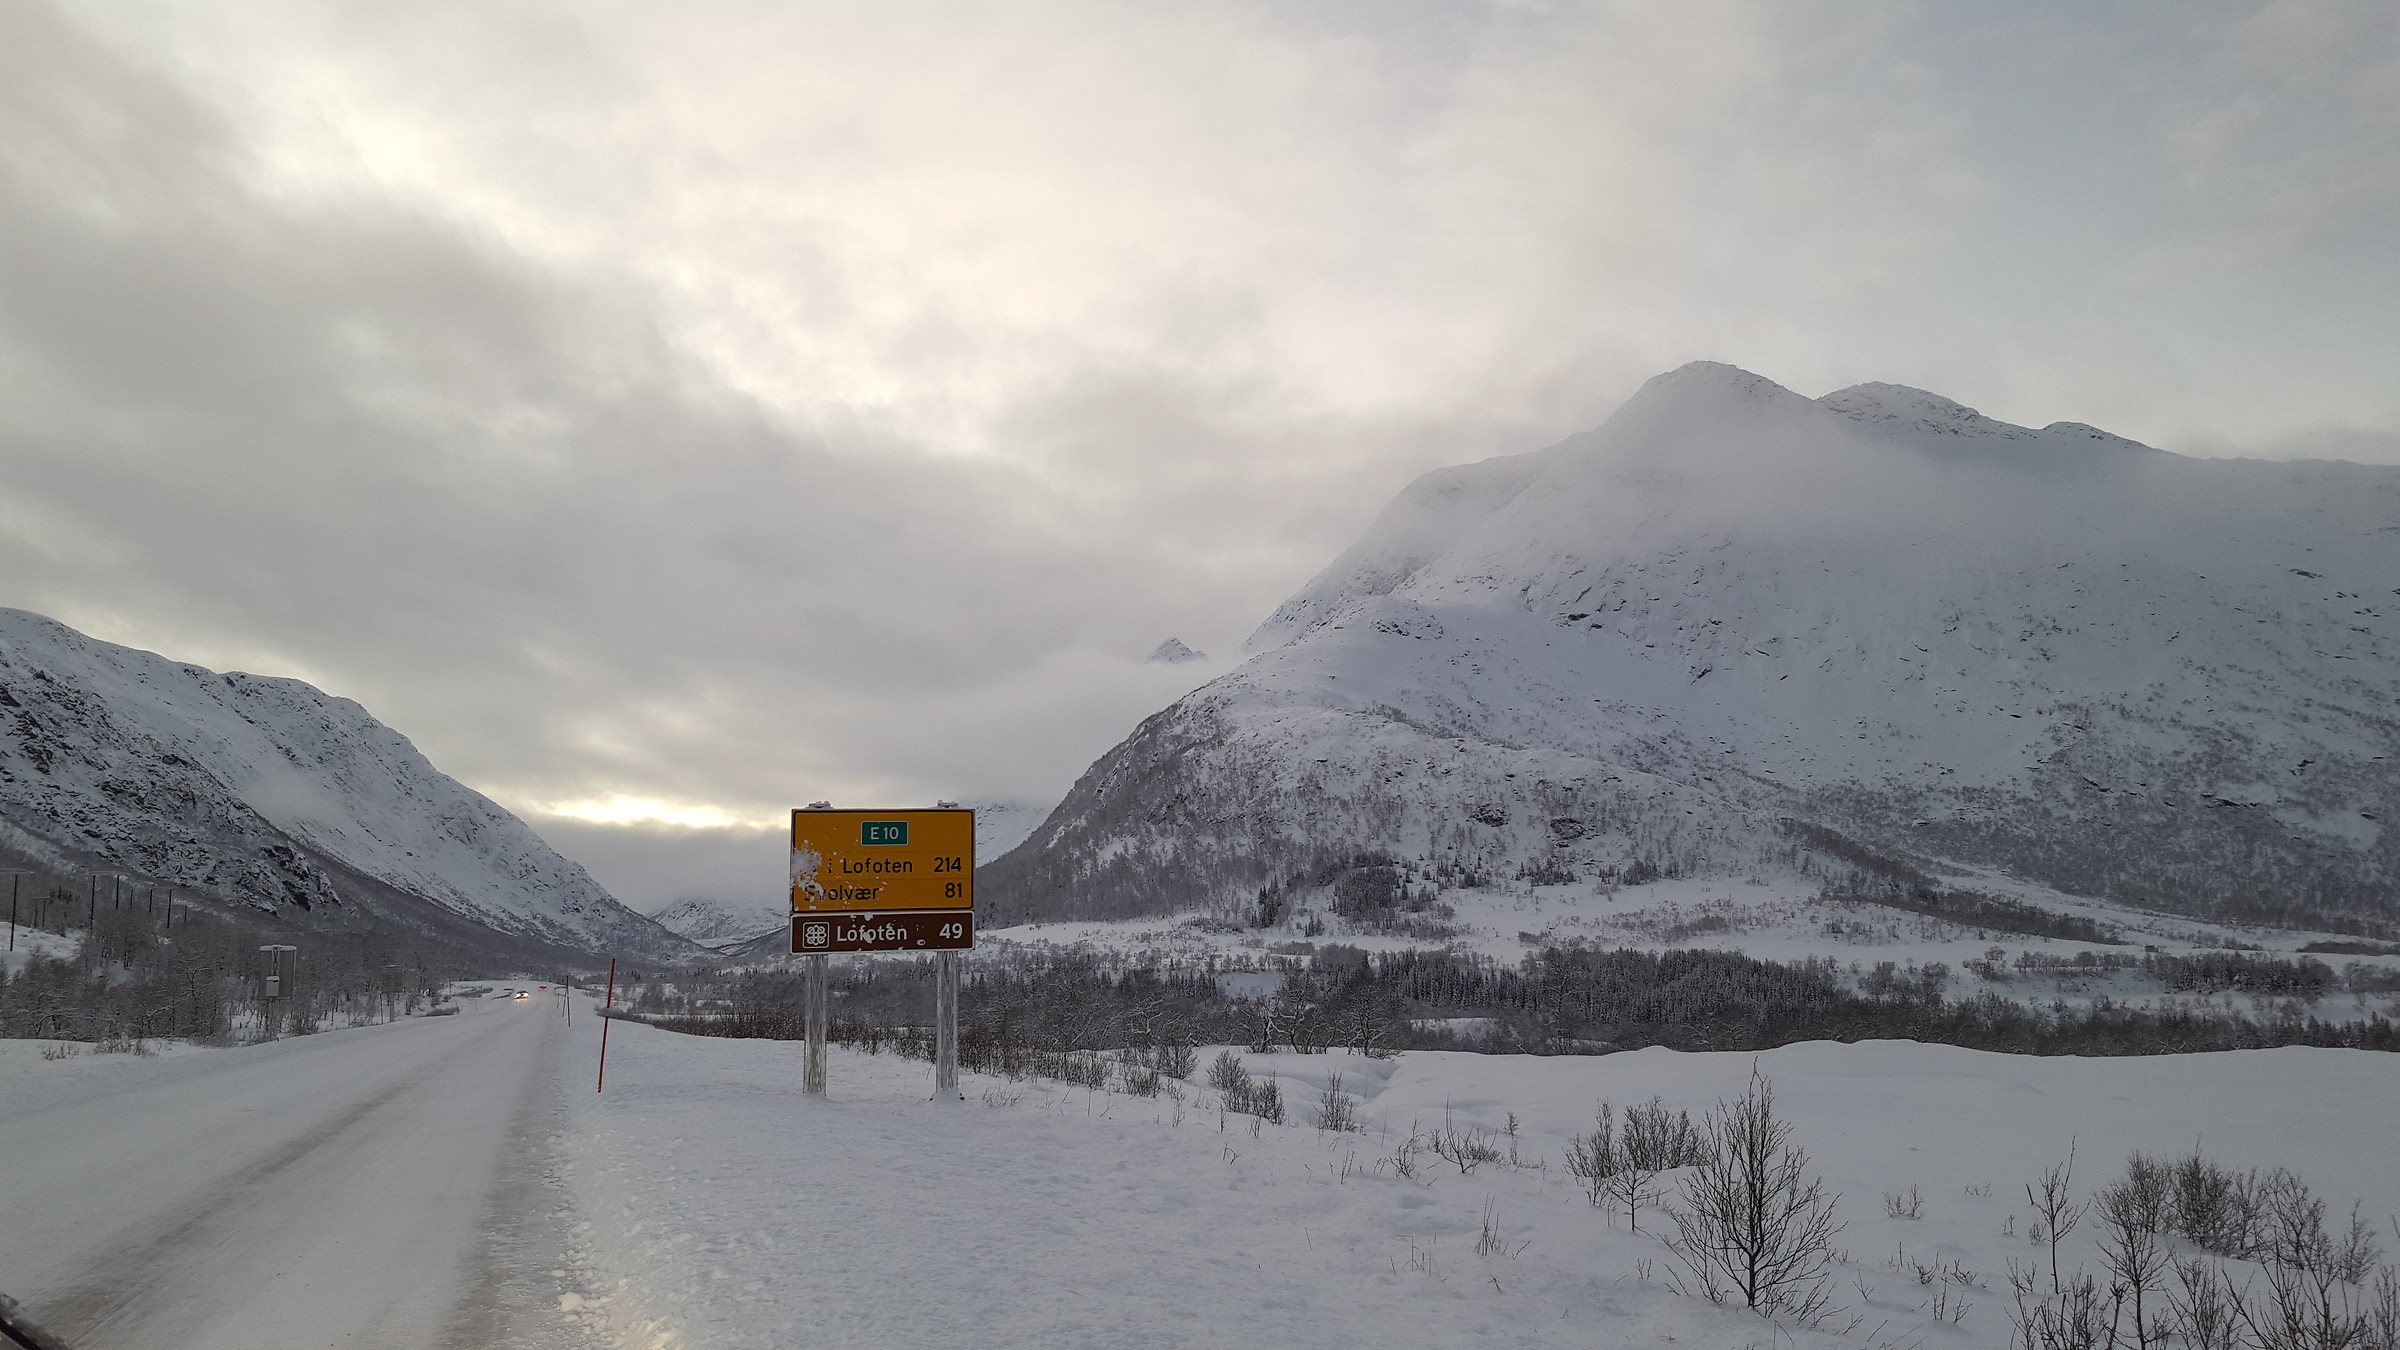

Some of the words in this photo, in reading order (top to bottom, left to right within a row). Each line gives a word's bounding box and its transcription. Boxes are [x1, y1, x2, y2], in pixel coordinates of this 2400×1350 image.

[870, 827, 879, 840] E
[883, 827, 899, 840] 10
[828, 858, 832, 874] i
[843, 858, 913, 874] Lofoten
[933, 857, 962, 873] 214
[944, 882, 963, 898] 81
[836, 924, 907, 942] Lofoten
[939, 923, 963, 939] 49
